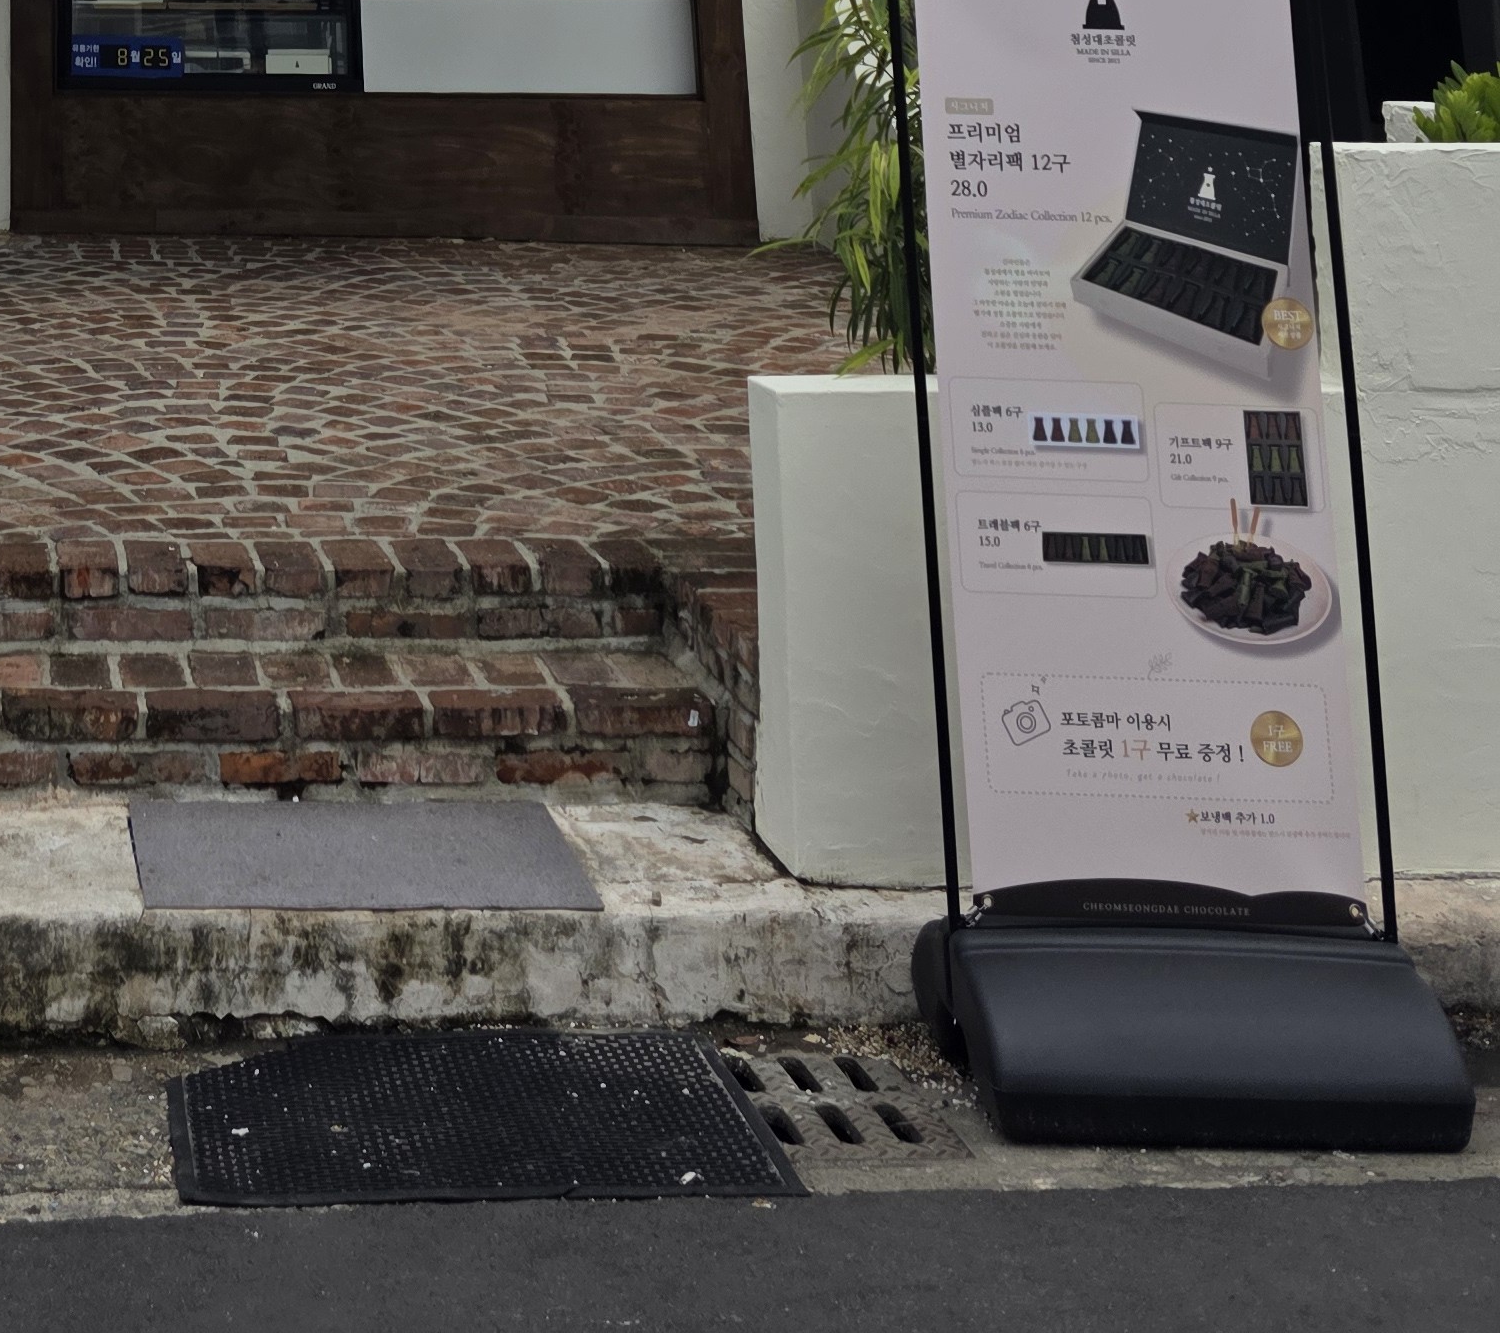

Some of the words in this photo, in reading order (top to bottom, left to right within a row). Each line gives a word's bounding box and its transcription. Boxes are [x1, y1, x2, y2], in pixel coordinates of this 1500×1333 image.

[947, 122, 1021, 144] 프리미엄
[949, 149, 1023, 172] 별자리팩
[1031, 153, 1072, 174] 12구
[950, 179, 988, 198] 28.0
[951, 207, 993, 219] Premium
[995, 208, 1028, 220] Zodiac
[1030, 209, 1078, 222] Collection
[1081, 211, 1093, 223] 12
[972, 421, 994, 433] 13.0
[1168, 435, 1212, 450] 기프트팩
[1215, 438, 1233, 451] 9구
[1170, 453, 1192, 465] 21.0
[979, 535, 1001, 547] 15.0
[1060, 711, 1121, 730] 포토콤마
[1126, 712, 1172, 732] 이용시
[1062, 738, 1115, 760] 초콜릿
[1120, 739, 1151, 761] 1구
[1156, 741, 1193, 761] 무료
[1197, 742, 1232, 763] 증정
[1262, 740, 1294, 753] FREE
[1200, 810, 1232, 824] 보냉백
[1235, 811, 1257, 825] 추가
[1260, 812, 1275, 825] 1.0
[1082, 902, 1180, 915] CHEOMSEONGDAE
[1183, 905, 1251, 917] CHOCOLATE
